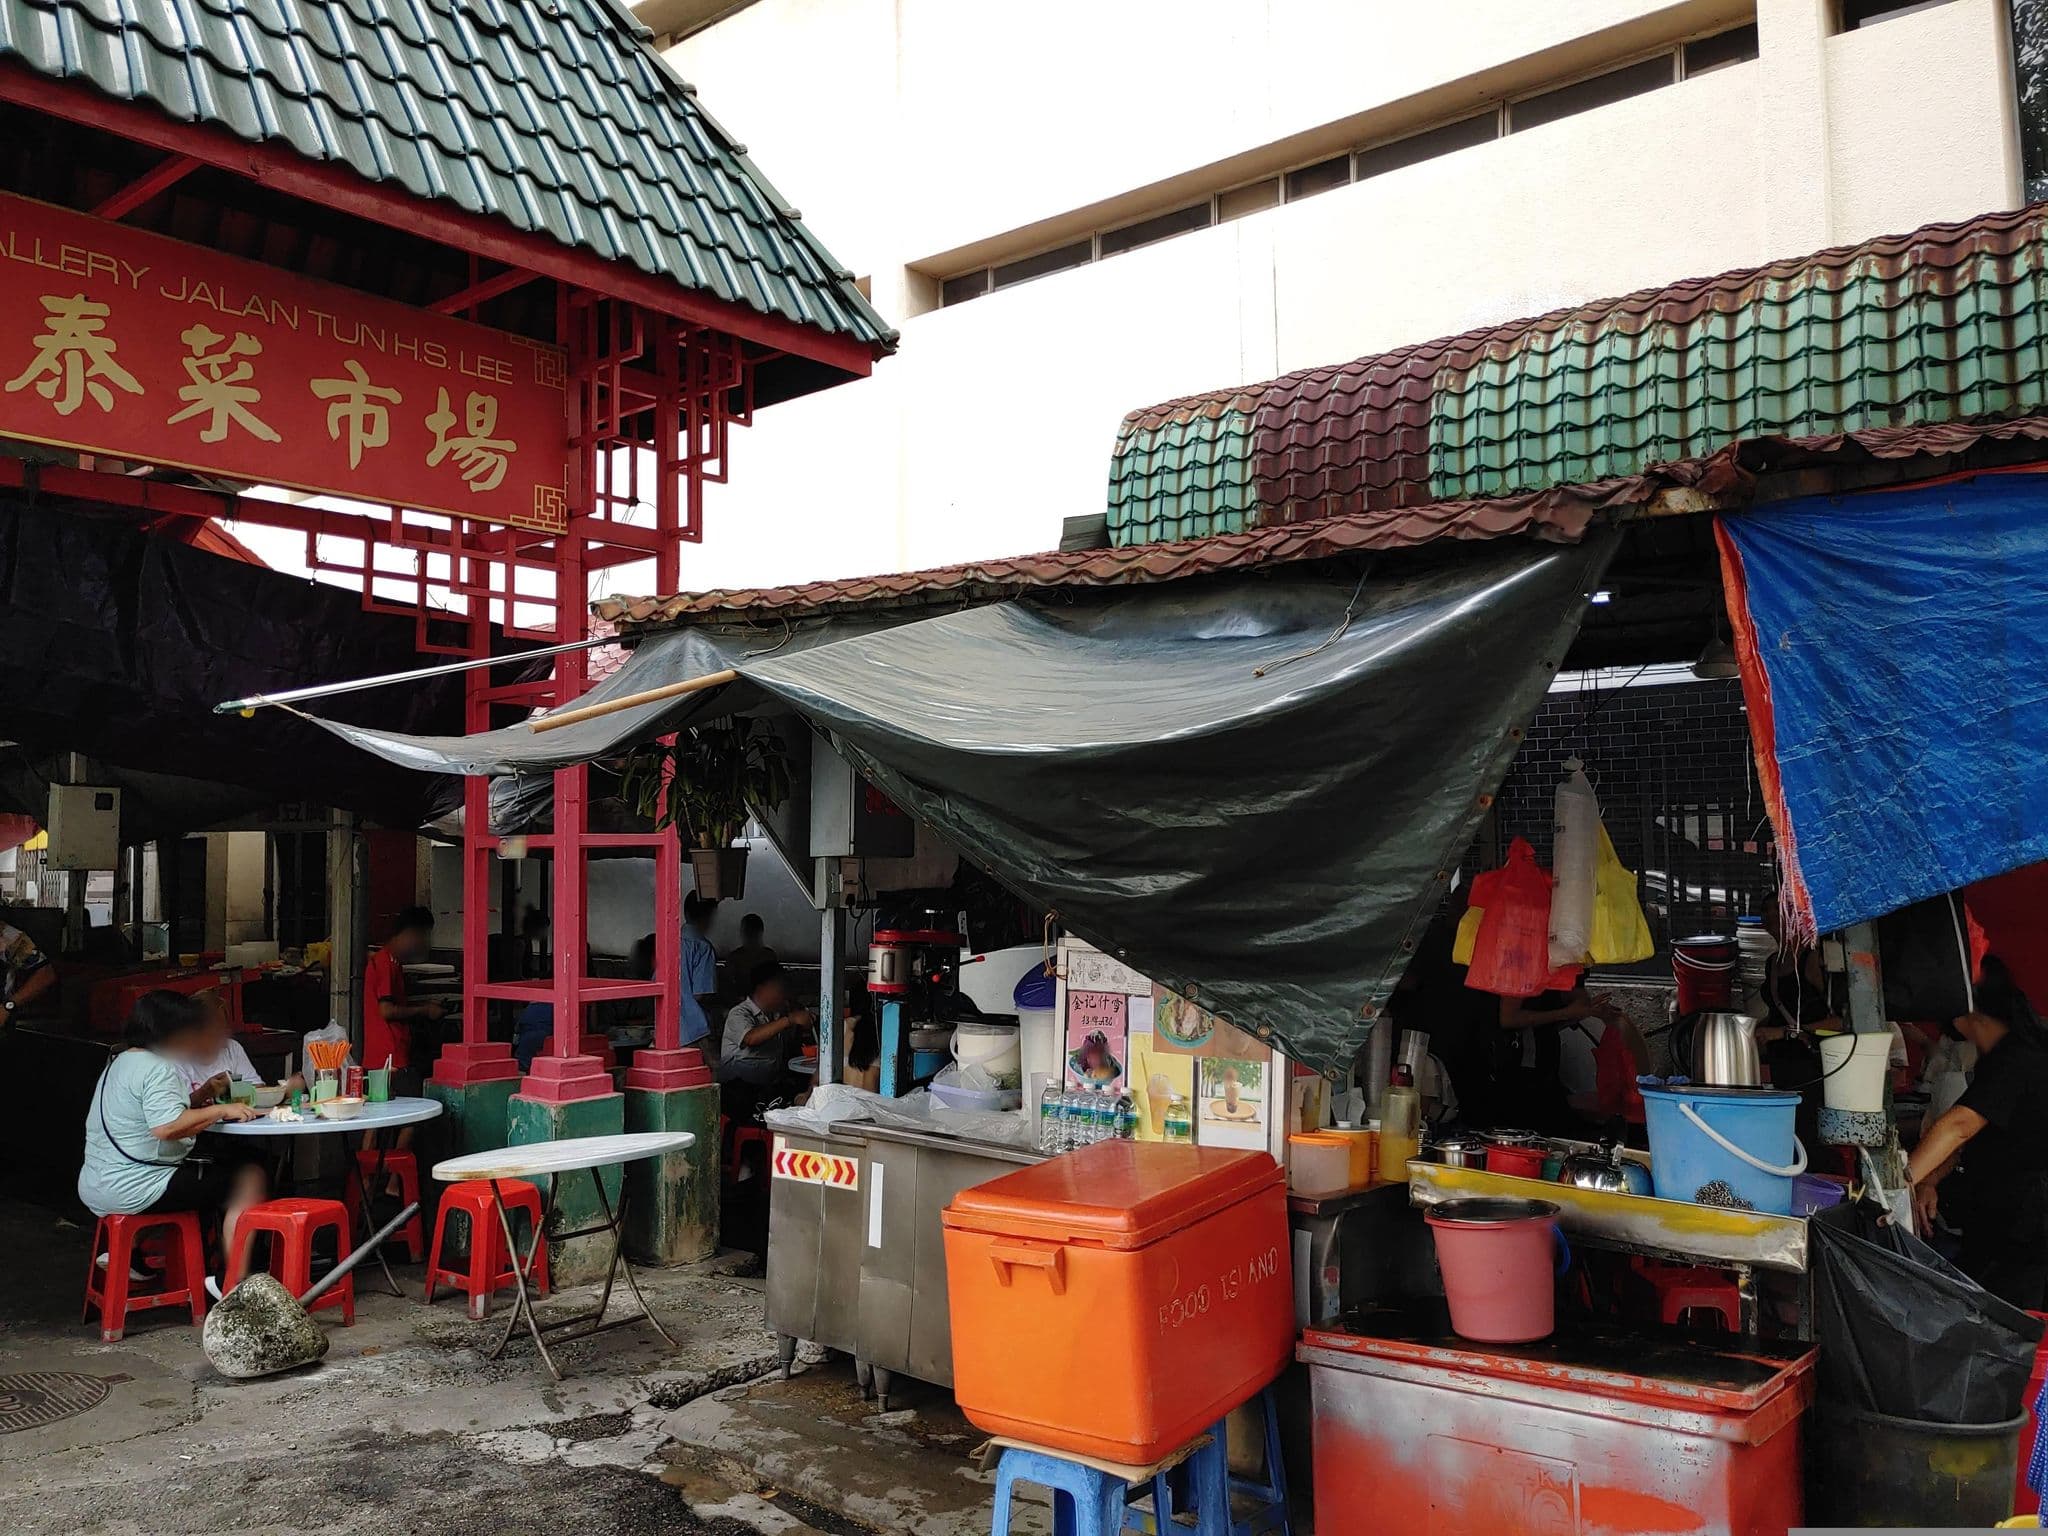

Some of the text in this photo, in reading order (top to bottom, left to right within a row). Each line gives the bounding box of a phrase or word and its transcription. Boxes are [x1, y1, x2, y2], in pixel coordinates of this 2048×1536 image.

[160, 276, 299, 331] JALAN
[308, 310, 386, 353] TUN
[395, 332, 453, 371] H.S.
[460, 349, 514, 386] LEE
